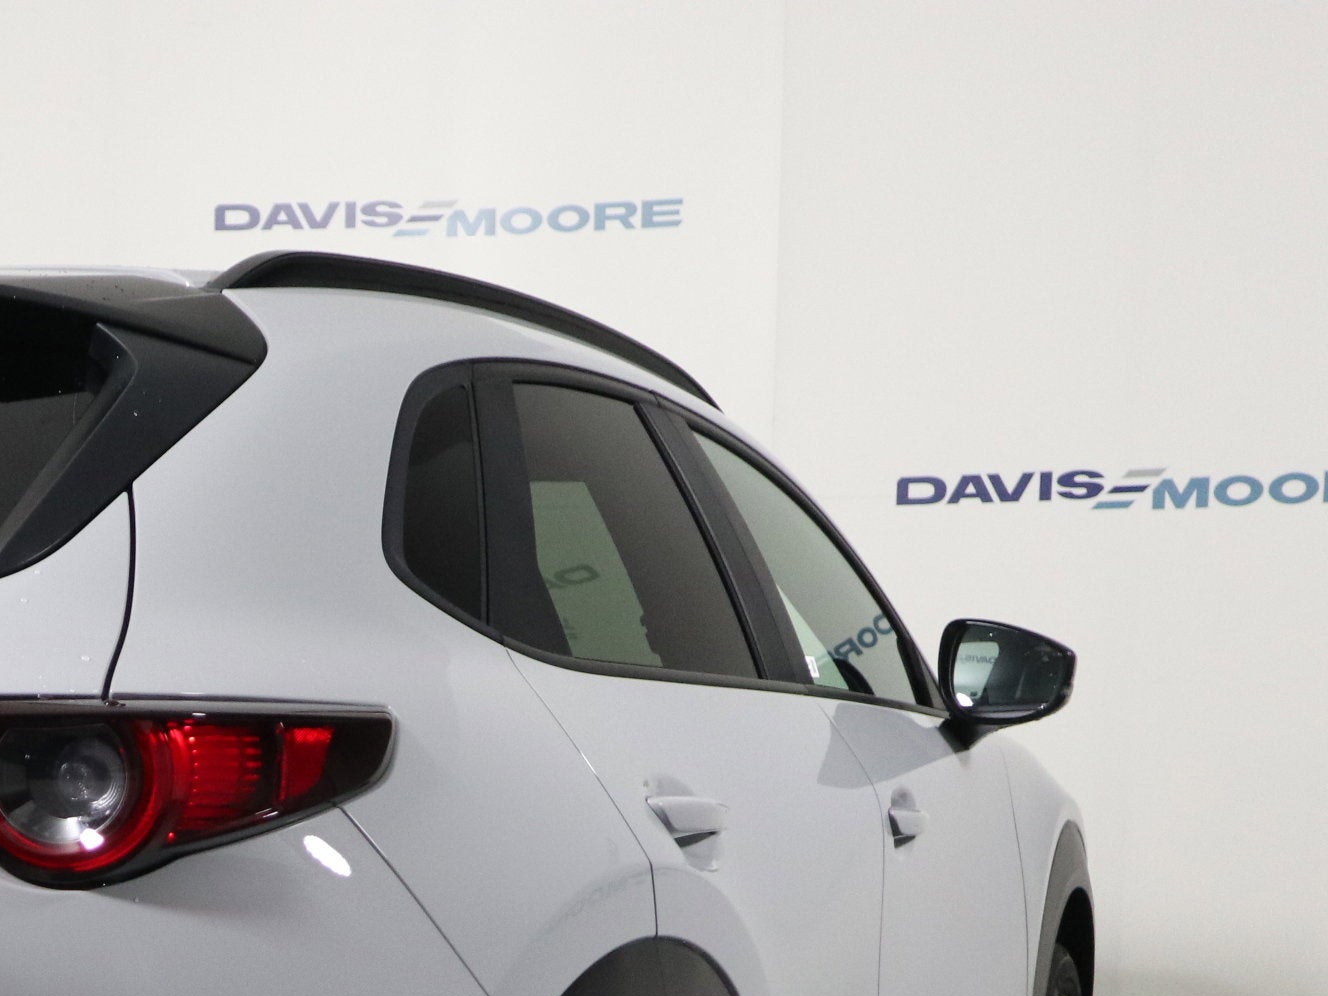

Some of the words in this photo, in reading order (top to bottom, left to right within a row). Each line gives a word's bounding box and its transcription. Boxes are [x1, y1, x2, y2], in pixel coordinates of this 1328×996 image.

[214, 200, 405, 232] DAVIS
[446, 198, 683, 237] MOORE
[896, 470, 1105, 506] DAVIS
[1152, 472, 1328, 510] MOO
